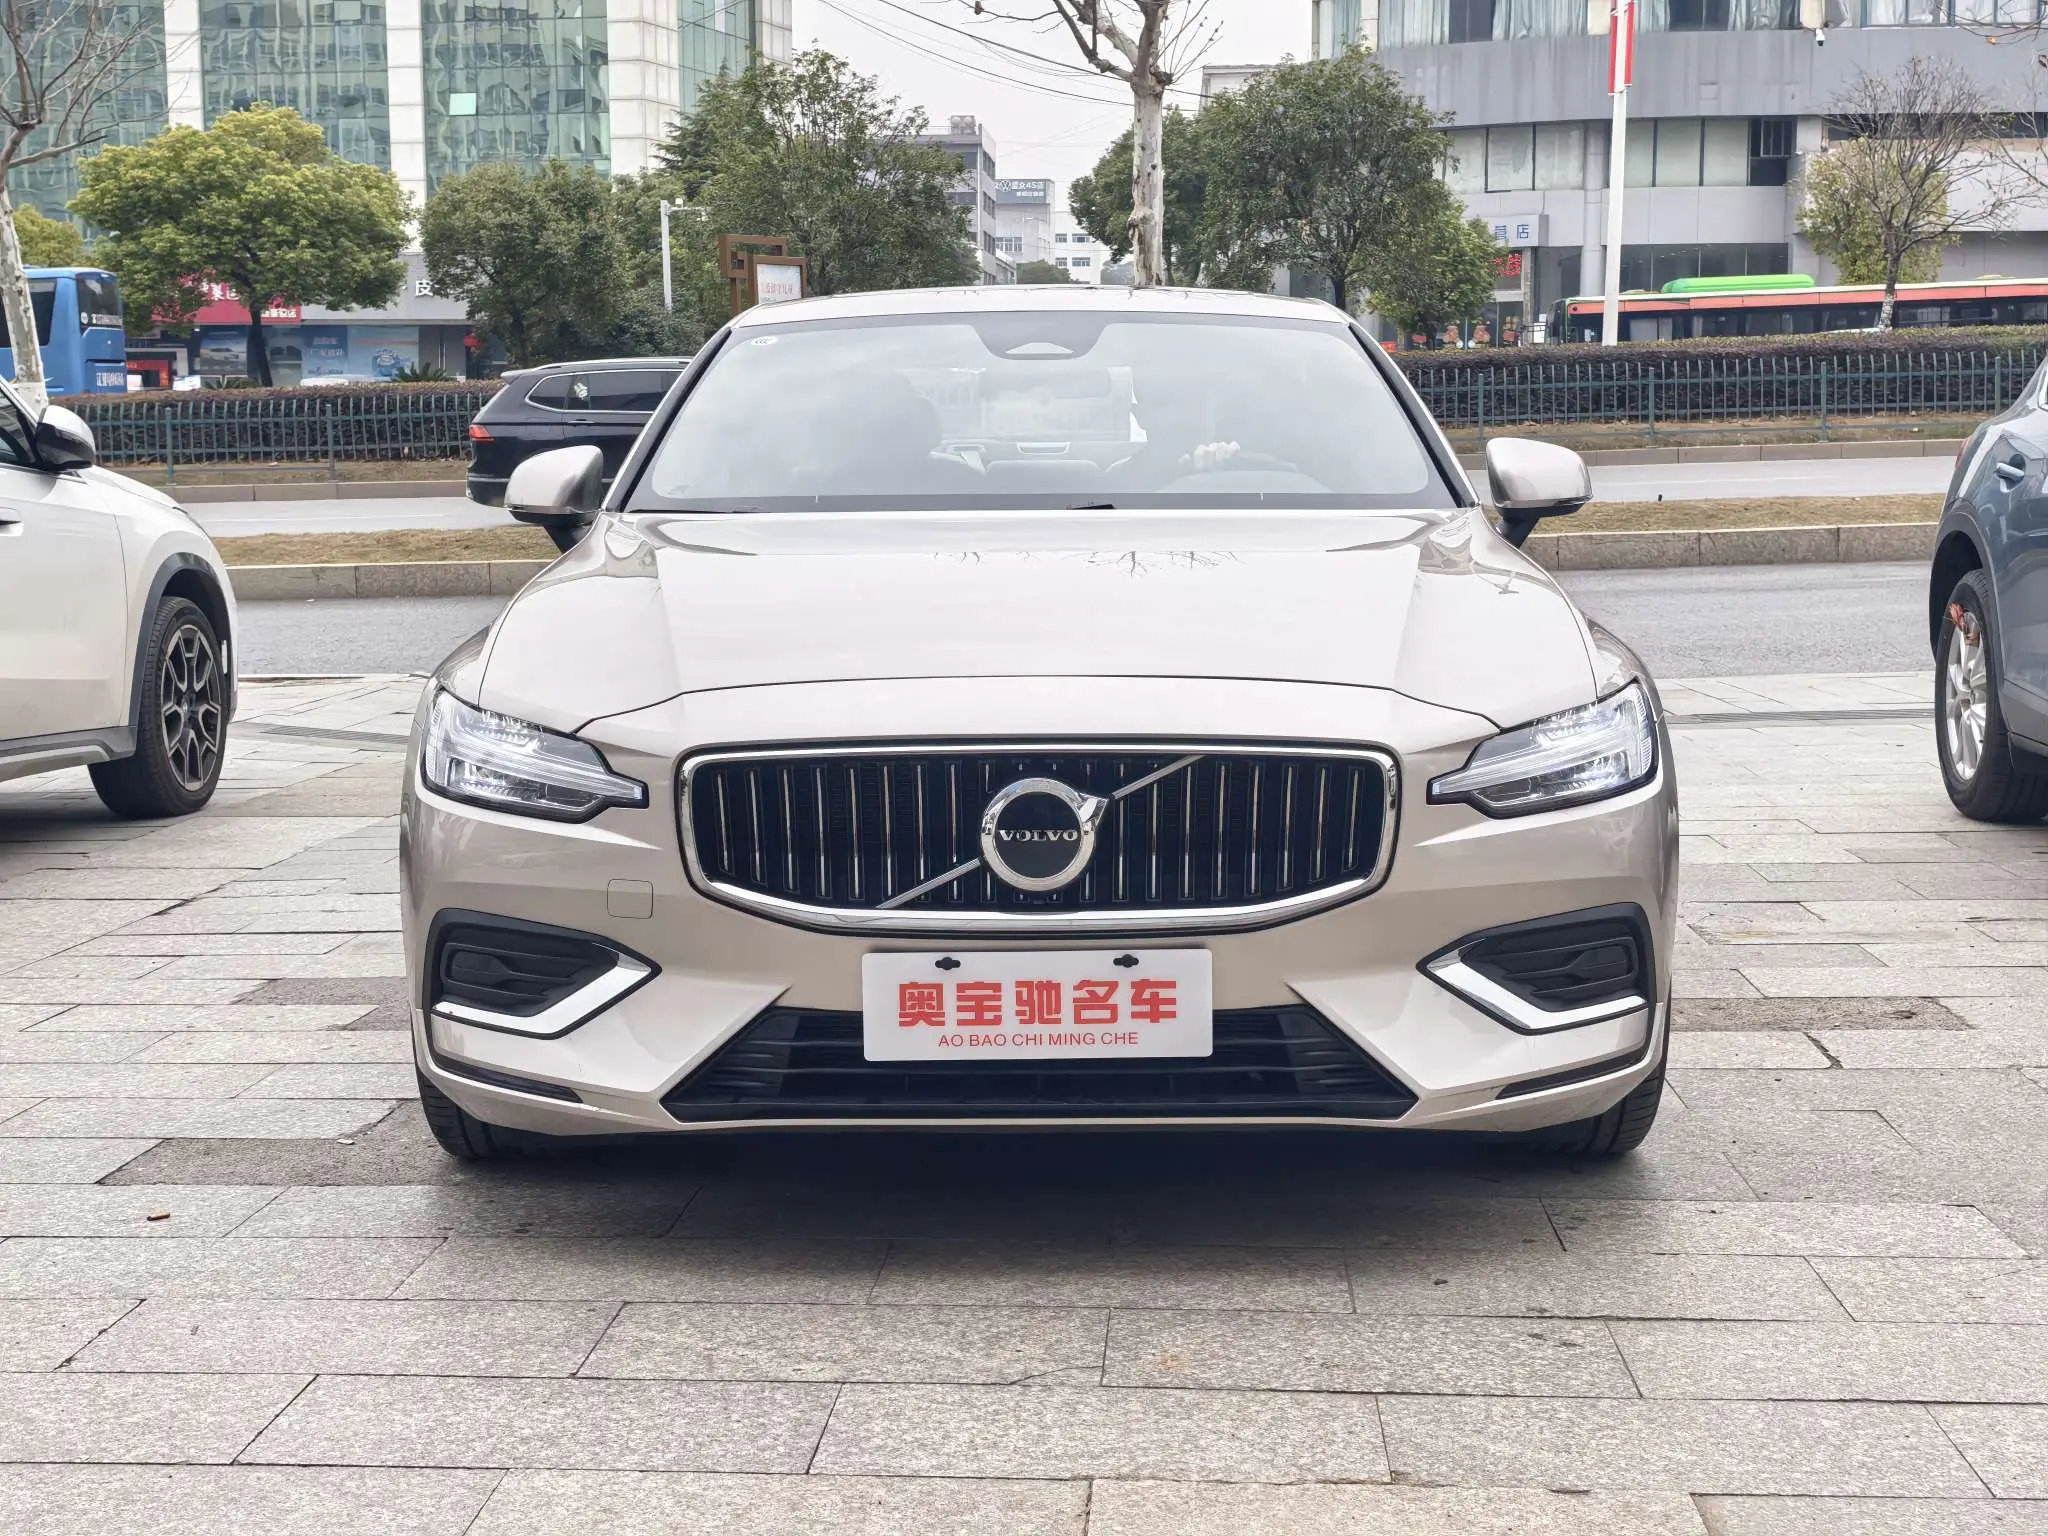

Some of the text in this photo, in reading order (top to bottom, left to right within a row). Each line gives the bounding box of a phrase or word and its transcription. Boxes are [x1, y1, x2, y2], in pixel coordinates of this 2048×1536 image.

[999, 829, 1079, 842] VOLVO
[898, 979, 1177, 1027] 奥宝驰名车
[938, 1031, 1139, 1048] AO BAO CHI MING CHE
